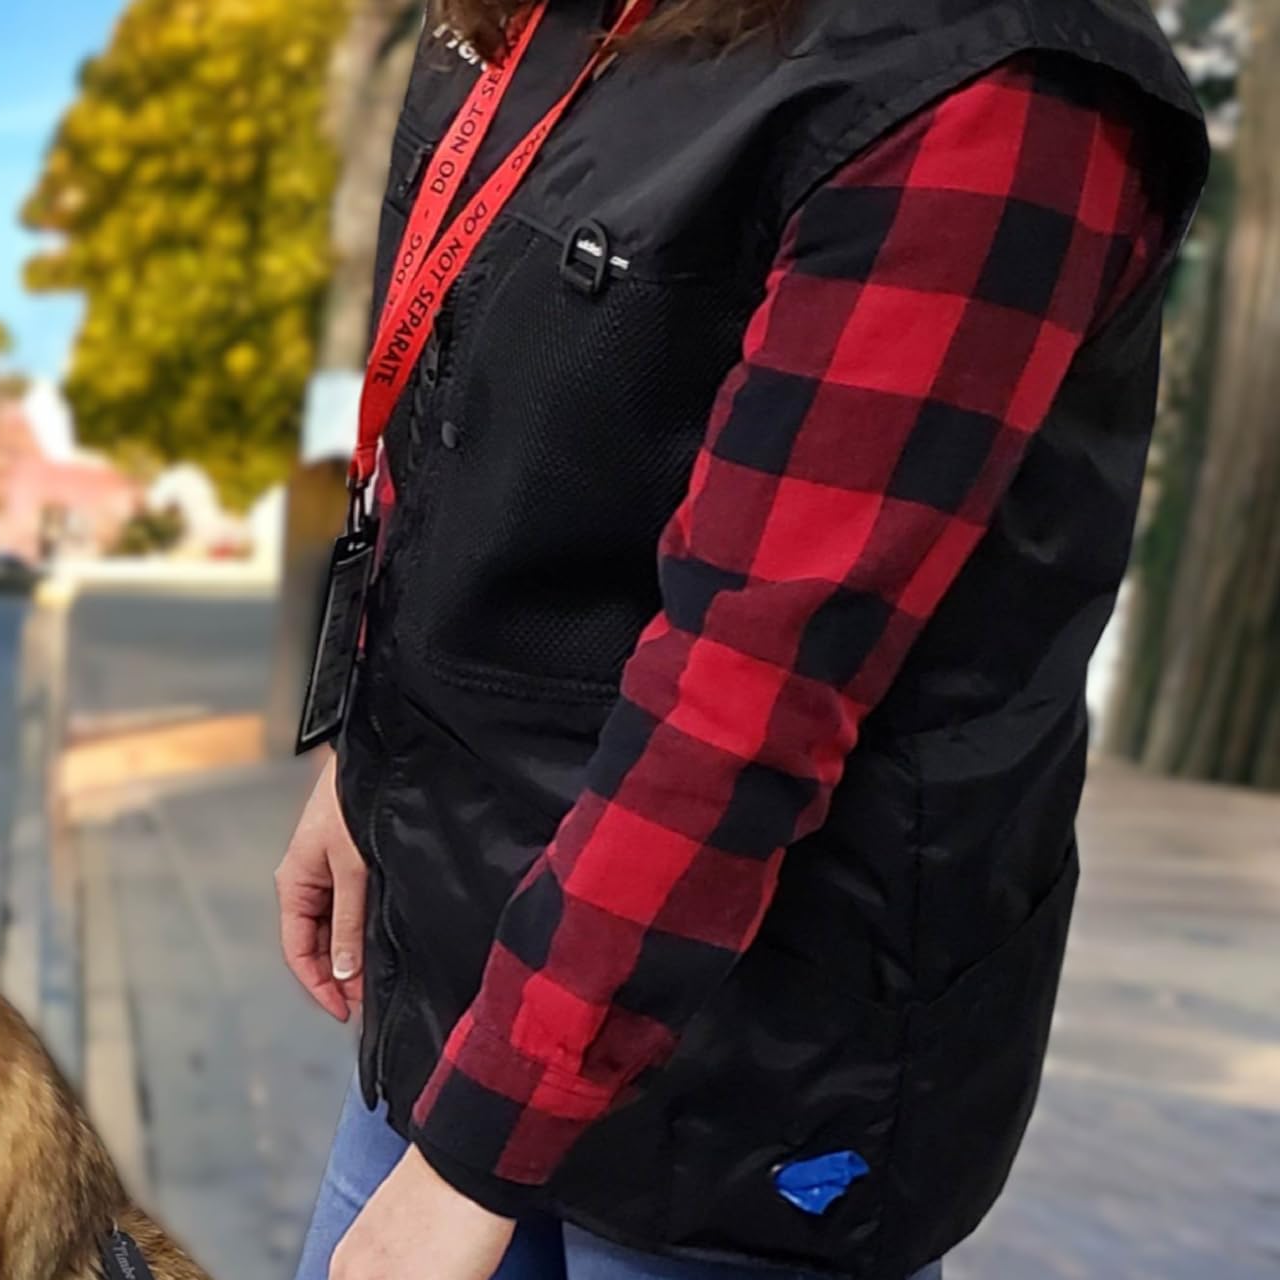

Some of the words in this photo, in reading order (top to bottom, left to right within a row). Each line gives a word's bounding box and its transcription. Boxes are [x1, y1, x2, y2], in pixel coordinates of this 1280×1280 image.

[396, 233, 423, 285] DOG
[429, 160, 455, 194] DO
[450, 101, 485, 154] NOT
[463, 201, 489, 235] DO
[431, 237, 465, 289] NOT
[373, 286, 435, 388] SEPARATE
